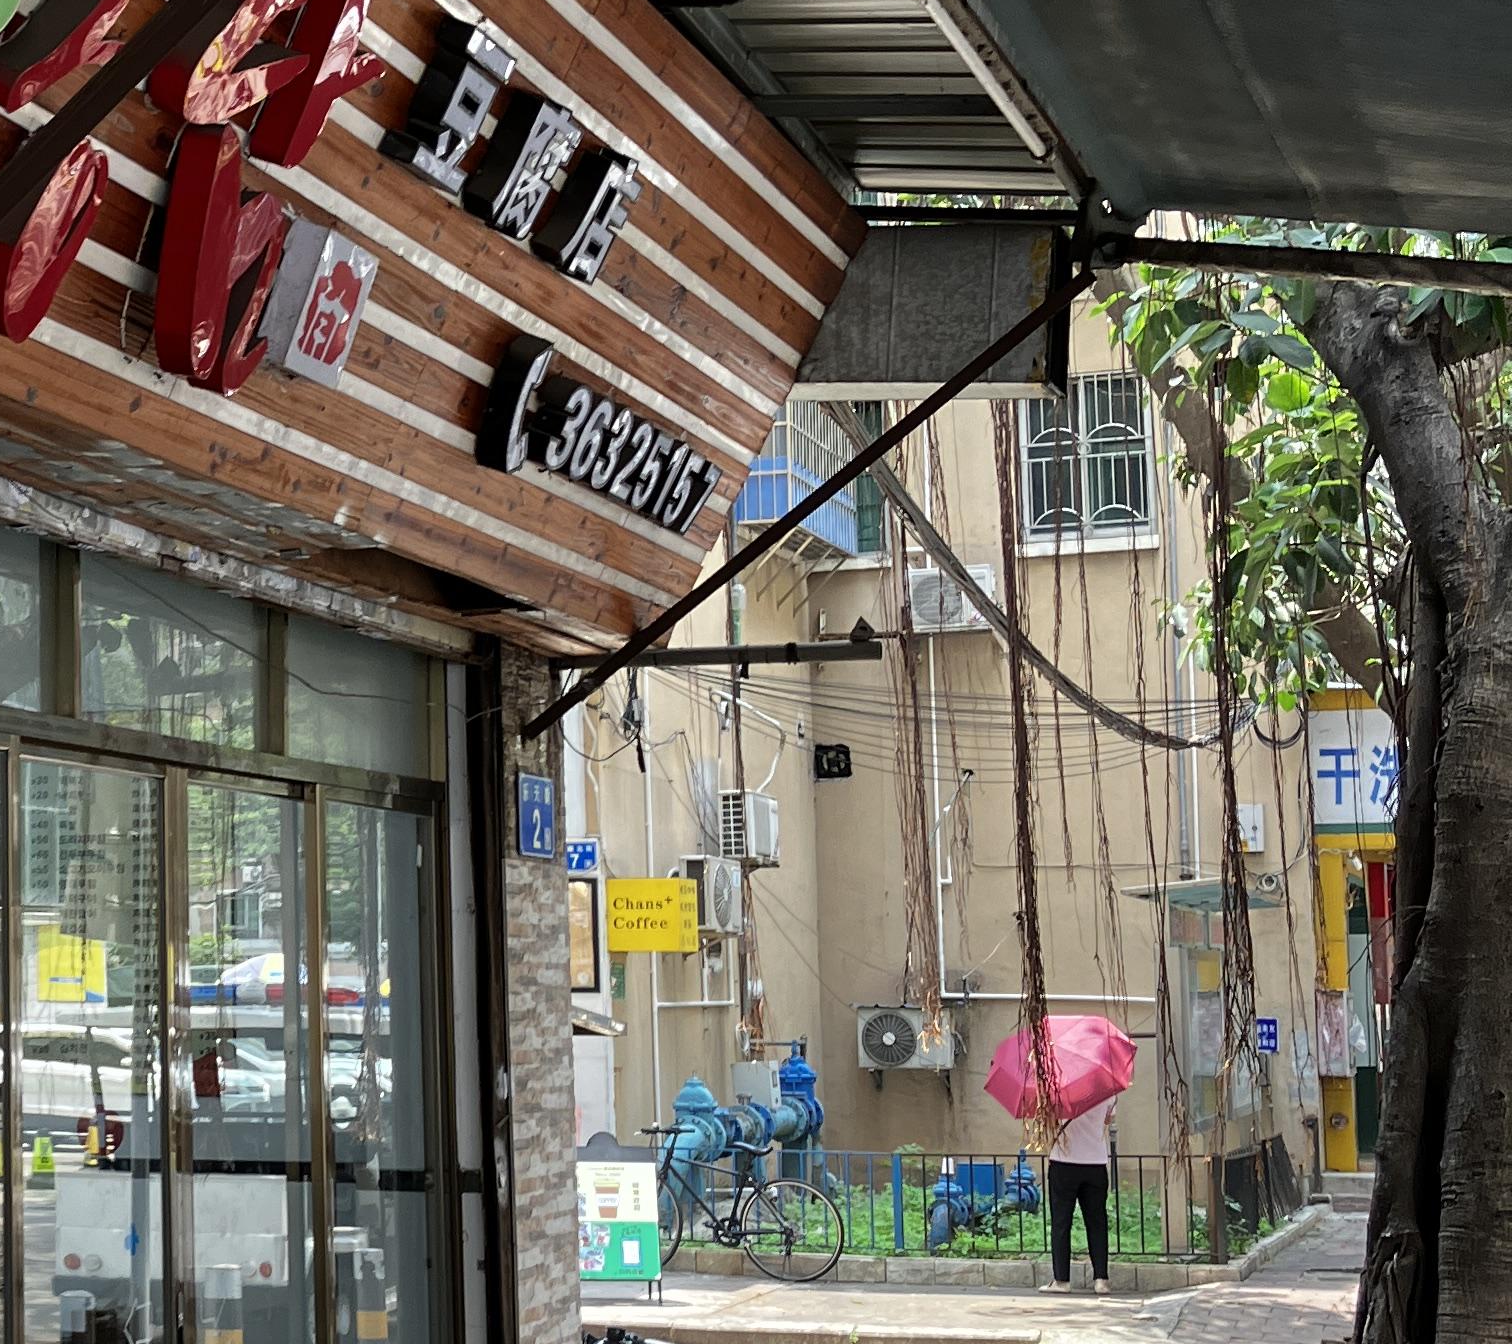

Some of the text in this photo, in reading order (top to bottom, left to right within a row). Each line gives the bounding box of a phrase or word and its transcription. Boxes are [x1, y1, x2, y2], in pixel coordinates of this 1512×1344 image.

[412, 24, 643, 286] 豆腐店
[545, 385, 724, 536] 36325157
[532, 808, 541, 849] 2
[570, 853, 579, 868] 7
[613, 917, 668, 929] Coffee
